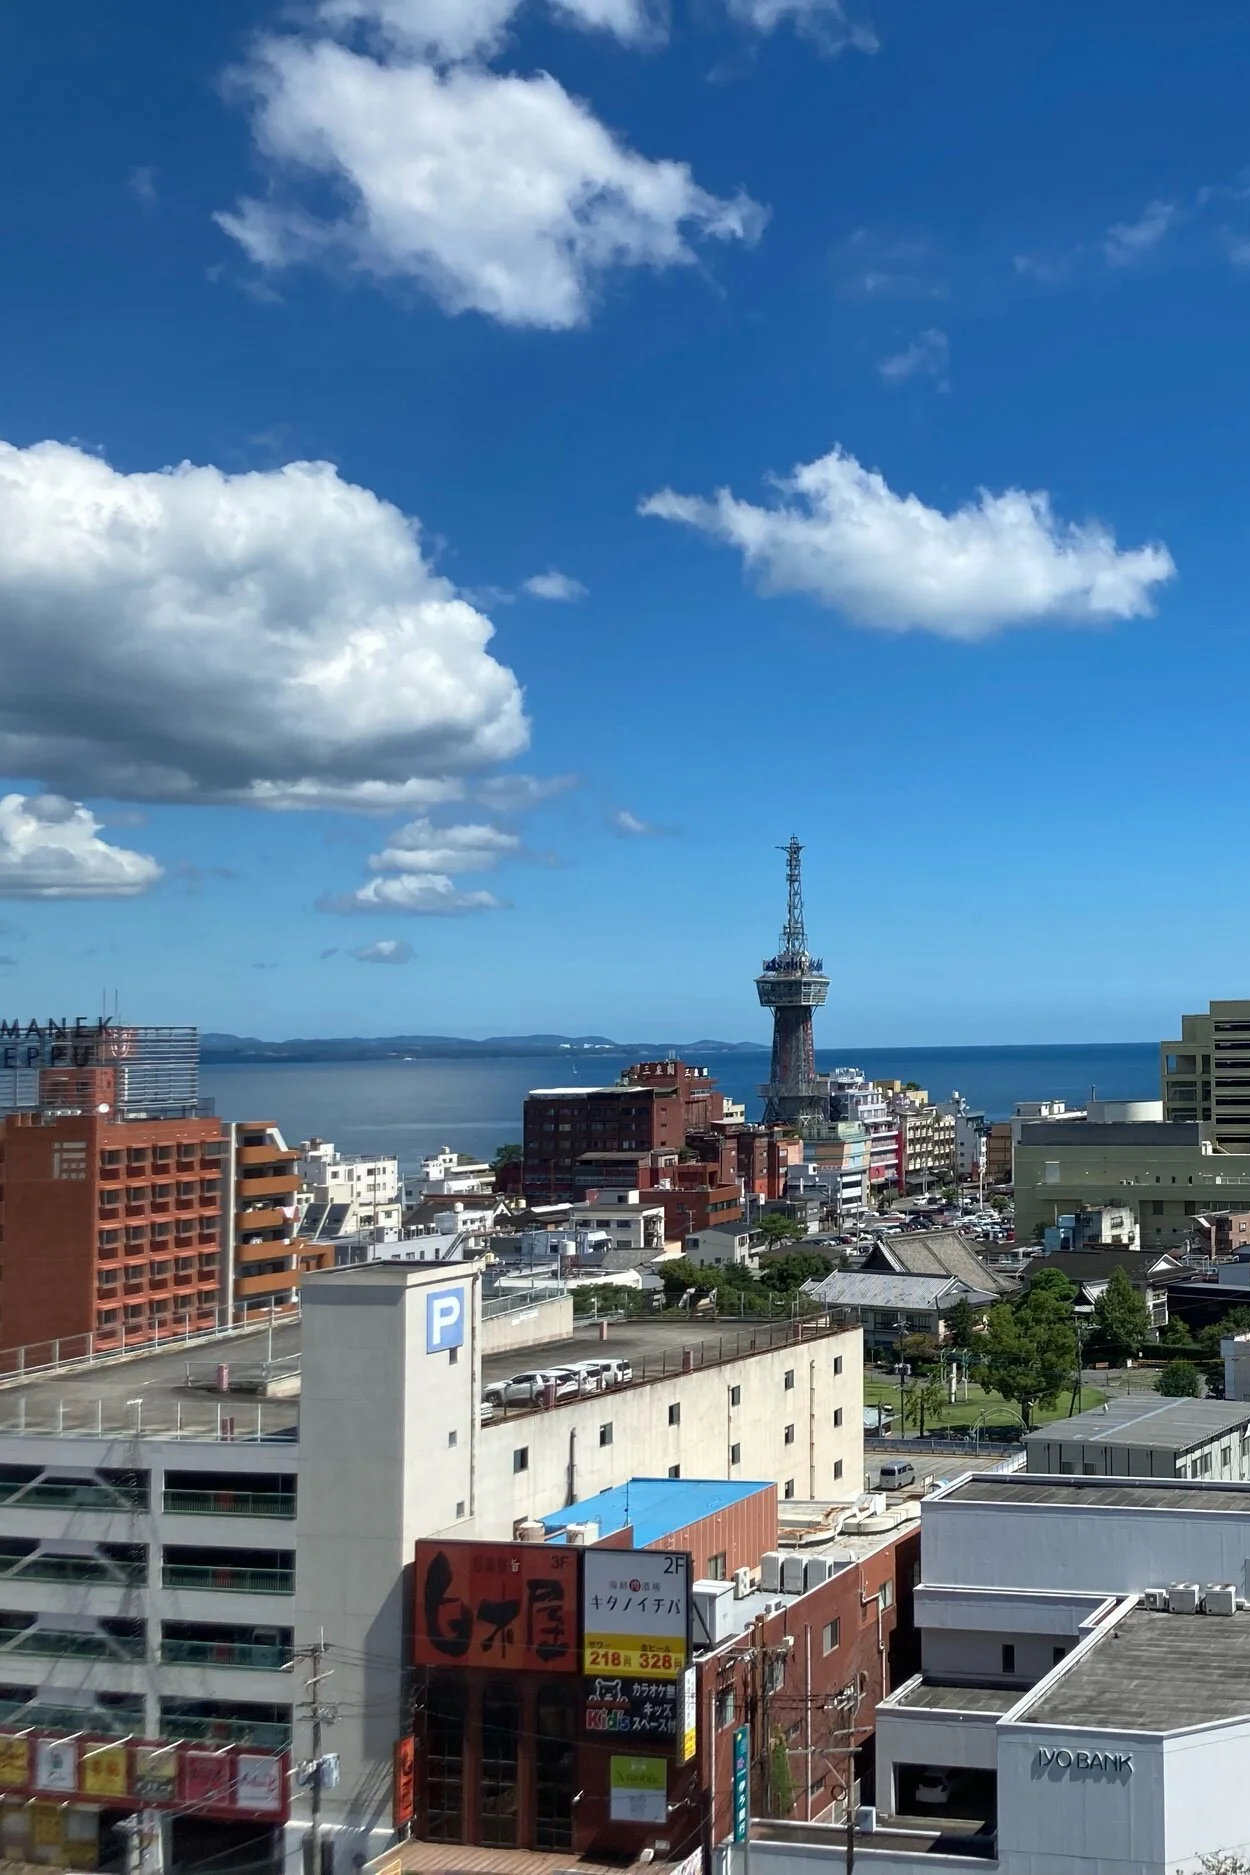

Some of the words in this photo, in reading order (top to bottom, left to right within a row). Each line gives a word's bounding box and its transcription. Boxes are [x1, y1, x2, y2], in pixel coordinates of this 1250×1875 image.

[433, 1296, 460, 1345] P
[552, 1555, 569, 1568] 3F
[664, 1556, 685, 1574] 2F
[590, 1595, 681, 1614] キタノイチバ
[1039, 1747, 1073, 1768] IYO
[1077, 1751, 1134, 1773] BANK
